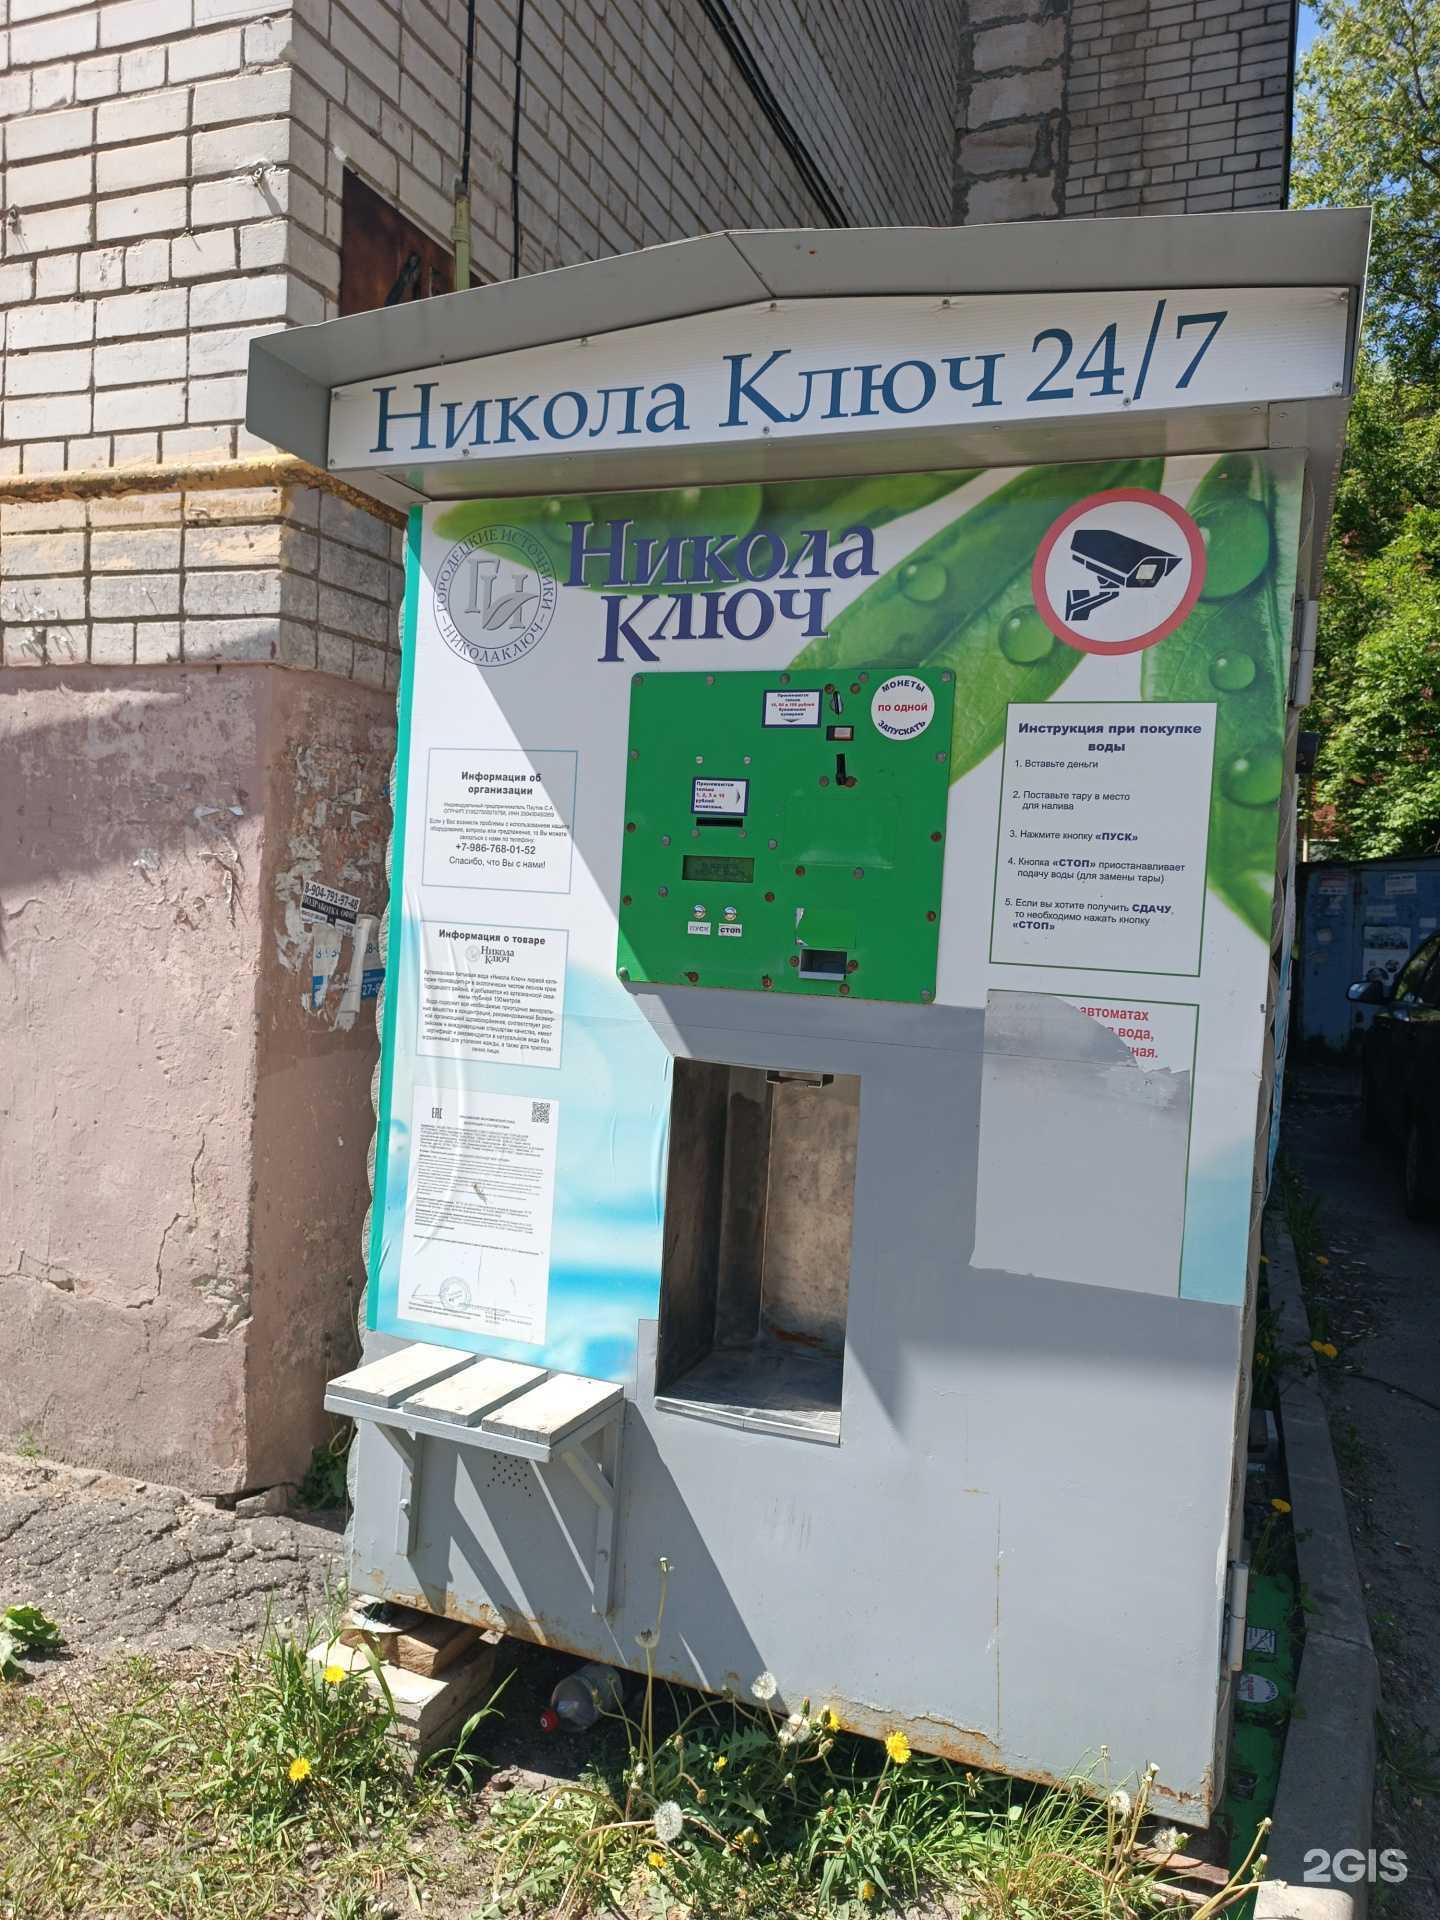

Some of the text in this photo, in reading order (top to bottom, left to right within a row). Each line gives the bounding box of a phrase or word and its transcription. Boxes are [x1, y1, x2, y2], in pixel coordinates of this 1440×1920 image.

[369, 299, 1229, 453] Никола Ключ 24/7
[563, 519, 880, 588] Никола
[436, 528, 554, 612] ГОРОДЕЦКИЕ ИСТОЧНИКИ
[598, 587, 832, 663] Ключ
[881, 679, 926, 693] МОНЕТЫ
[878, 703, 928, 712] ПО ОДНОЙ
[878, 720, 926, 736] ЗАПУСКАТЬ
[1018, 722, 1202, 736] Инструкция при покупке
[1088, 742, 1126, 752] воды
[1015, 760, 1099, 769] 1. Вставьте деньги
[461, 771, 542, 783] Информация об
[468, 785, 533, 795] организации
[1012, 791, 1020, 799] 2.
[1023, 791, 1069, 800] Поставьте
[1071, 793, 1092, 802] тару
[1009, 830, 1138, 842] 3. Нажмите кнопку «ПУСК»
[456, 843, 536, 854] +7-986-768-01-52
[449, 856, 485, 867] Спасибо,
[502, 859, 514, 868] Вы
[523, 861, 546, 869] нами!
[1008, 857, 1186, 872] 4. Кнопка «СТОП» приостанавливает
[1017, 870, 1165, 884] подачу воды (для замены тары)
[1005, 898, 1013, 906] 5.
[1015, 898, 1038, 907] Если
[1040, 901, 1052, 909] вы
[1087, 904, 1129, 913] получить
[1012, 921, 1055, 930] «СТОП»
[1027, 912, 1081, 921] необходимо
[1084, 914, 1117, 923] нажать
[1119, 917, 1150, 926] кнопку
[439, 929, 500, 942] Информация
[513, 936, 546, 945] товаре
[481, 945, 515, 957] Никола
[1118, 1027, 1154, 1042] вода,
